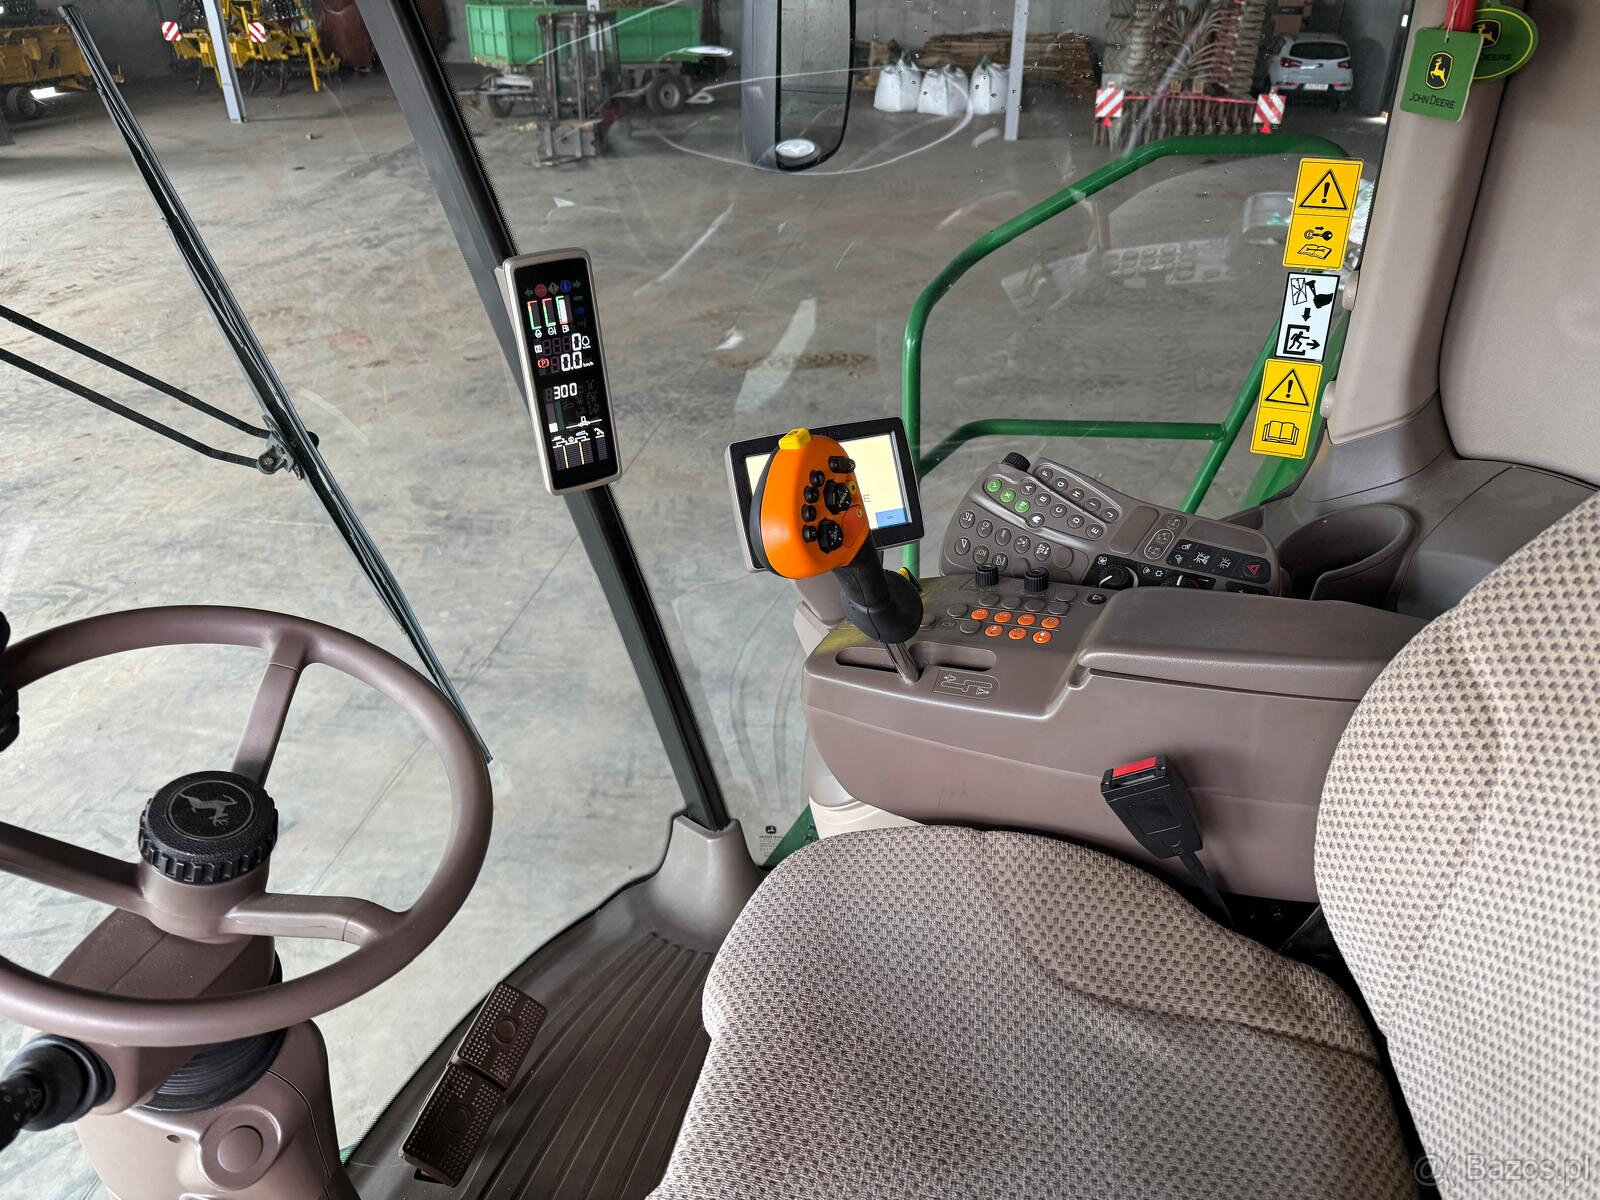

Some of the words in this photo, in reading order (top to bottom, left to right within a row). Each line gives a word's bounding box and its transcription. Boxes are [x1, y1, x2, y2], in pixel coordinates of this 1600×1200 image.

[1409, 91, 1430, 104] JOHN
[1429, 95, 1456, 109] DEERE
[572, 333, 581, 351] 0
[561, 351, 583, 371] 0.0
[553, 383, 577, 400] 300
